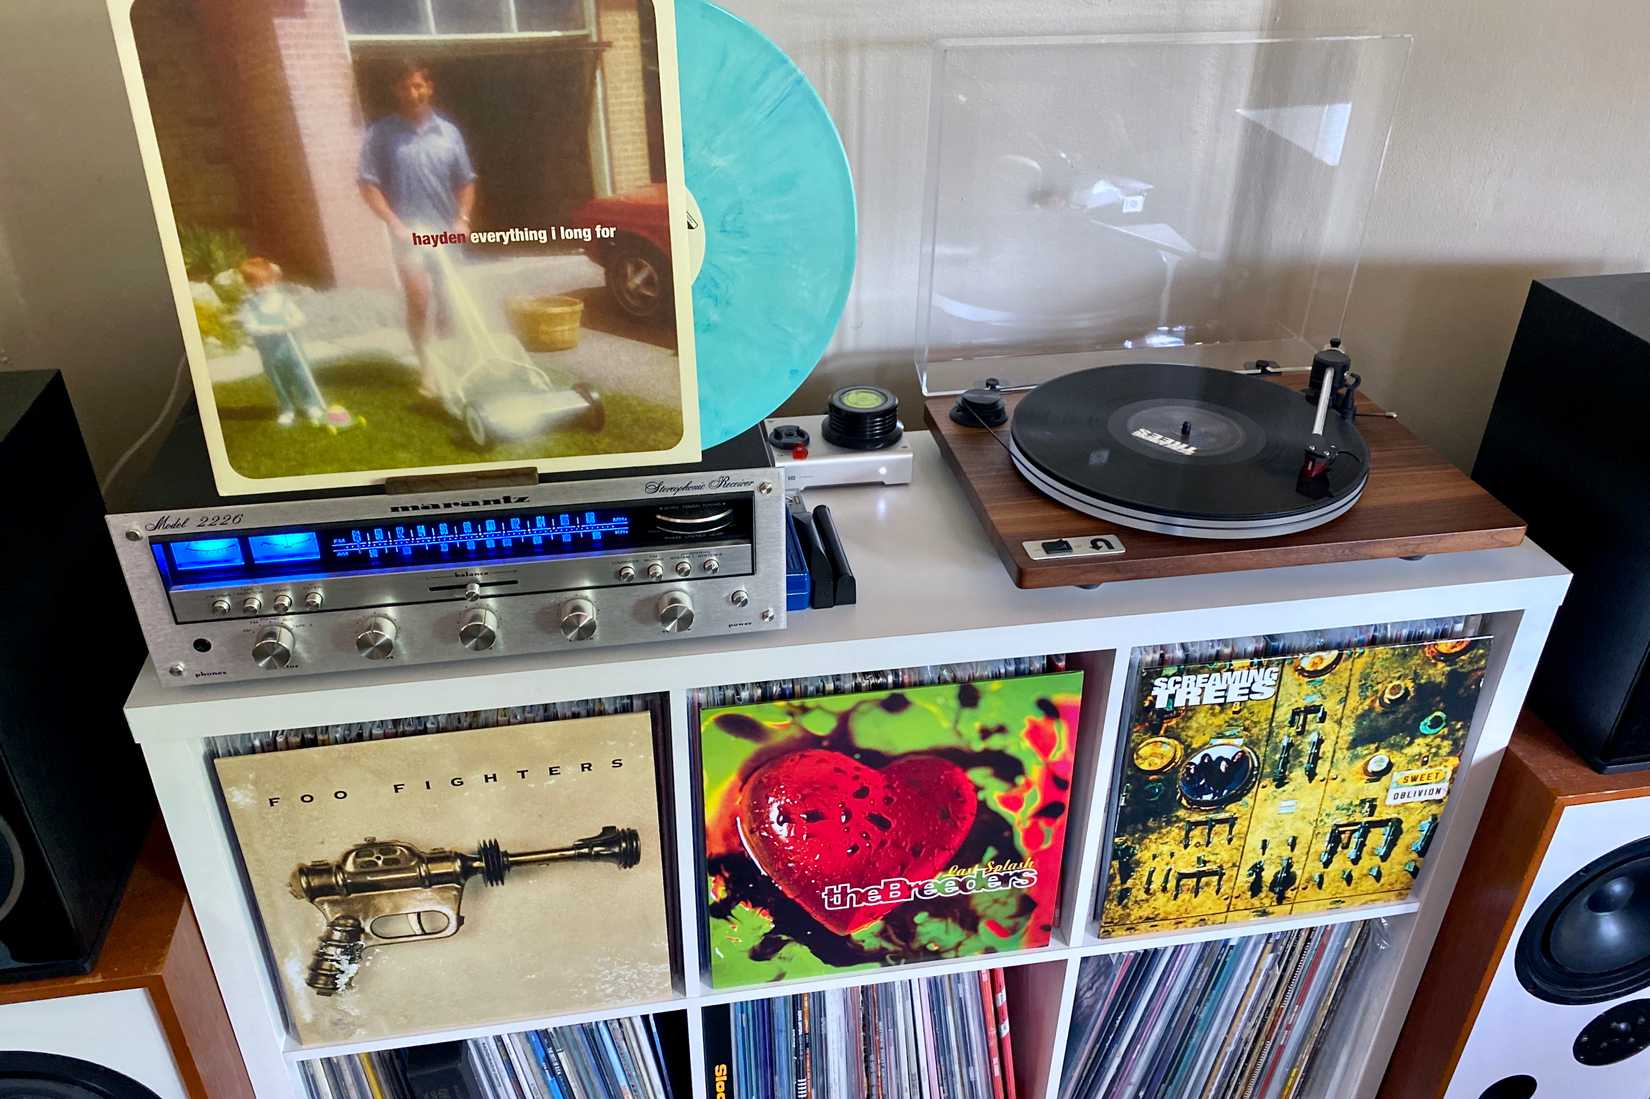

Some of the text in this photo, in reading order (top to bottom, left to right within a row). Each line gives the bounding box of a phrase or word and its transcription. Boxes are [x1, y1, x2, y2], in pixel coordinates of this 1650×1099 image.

[412, 225, 617, 248] hayden everything i long for
[645, 475, 755, 495] Stereophonic Receiver
[390, 495, 530, 513] marantz
[145, 513, 244, 531] Model 2226
[195, 671, 227, 679] phones
[1152, 667, 1280, 691] SCREAMING
[1151, 680, 1277, 709] TREES
[268, 758, 623, 808] FOO FIGHTERS
[1402, 772, 1441, 784] SWEET
[1393, 787, 1442, 801] OBLIVION
[947, 857, 1035, 876] Last Splash
